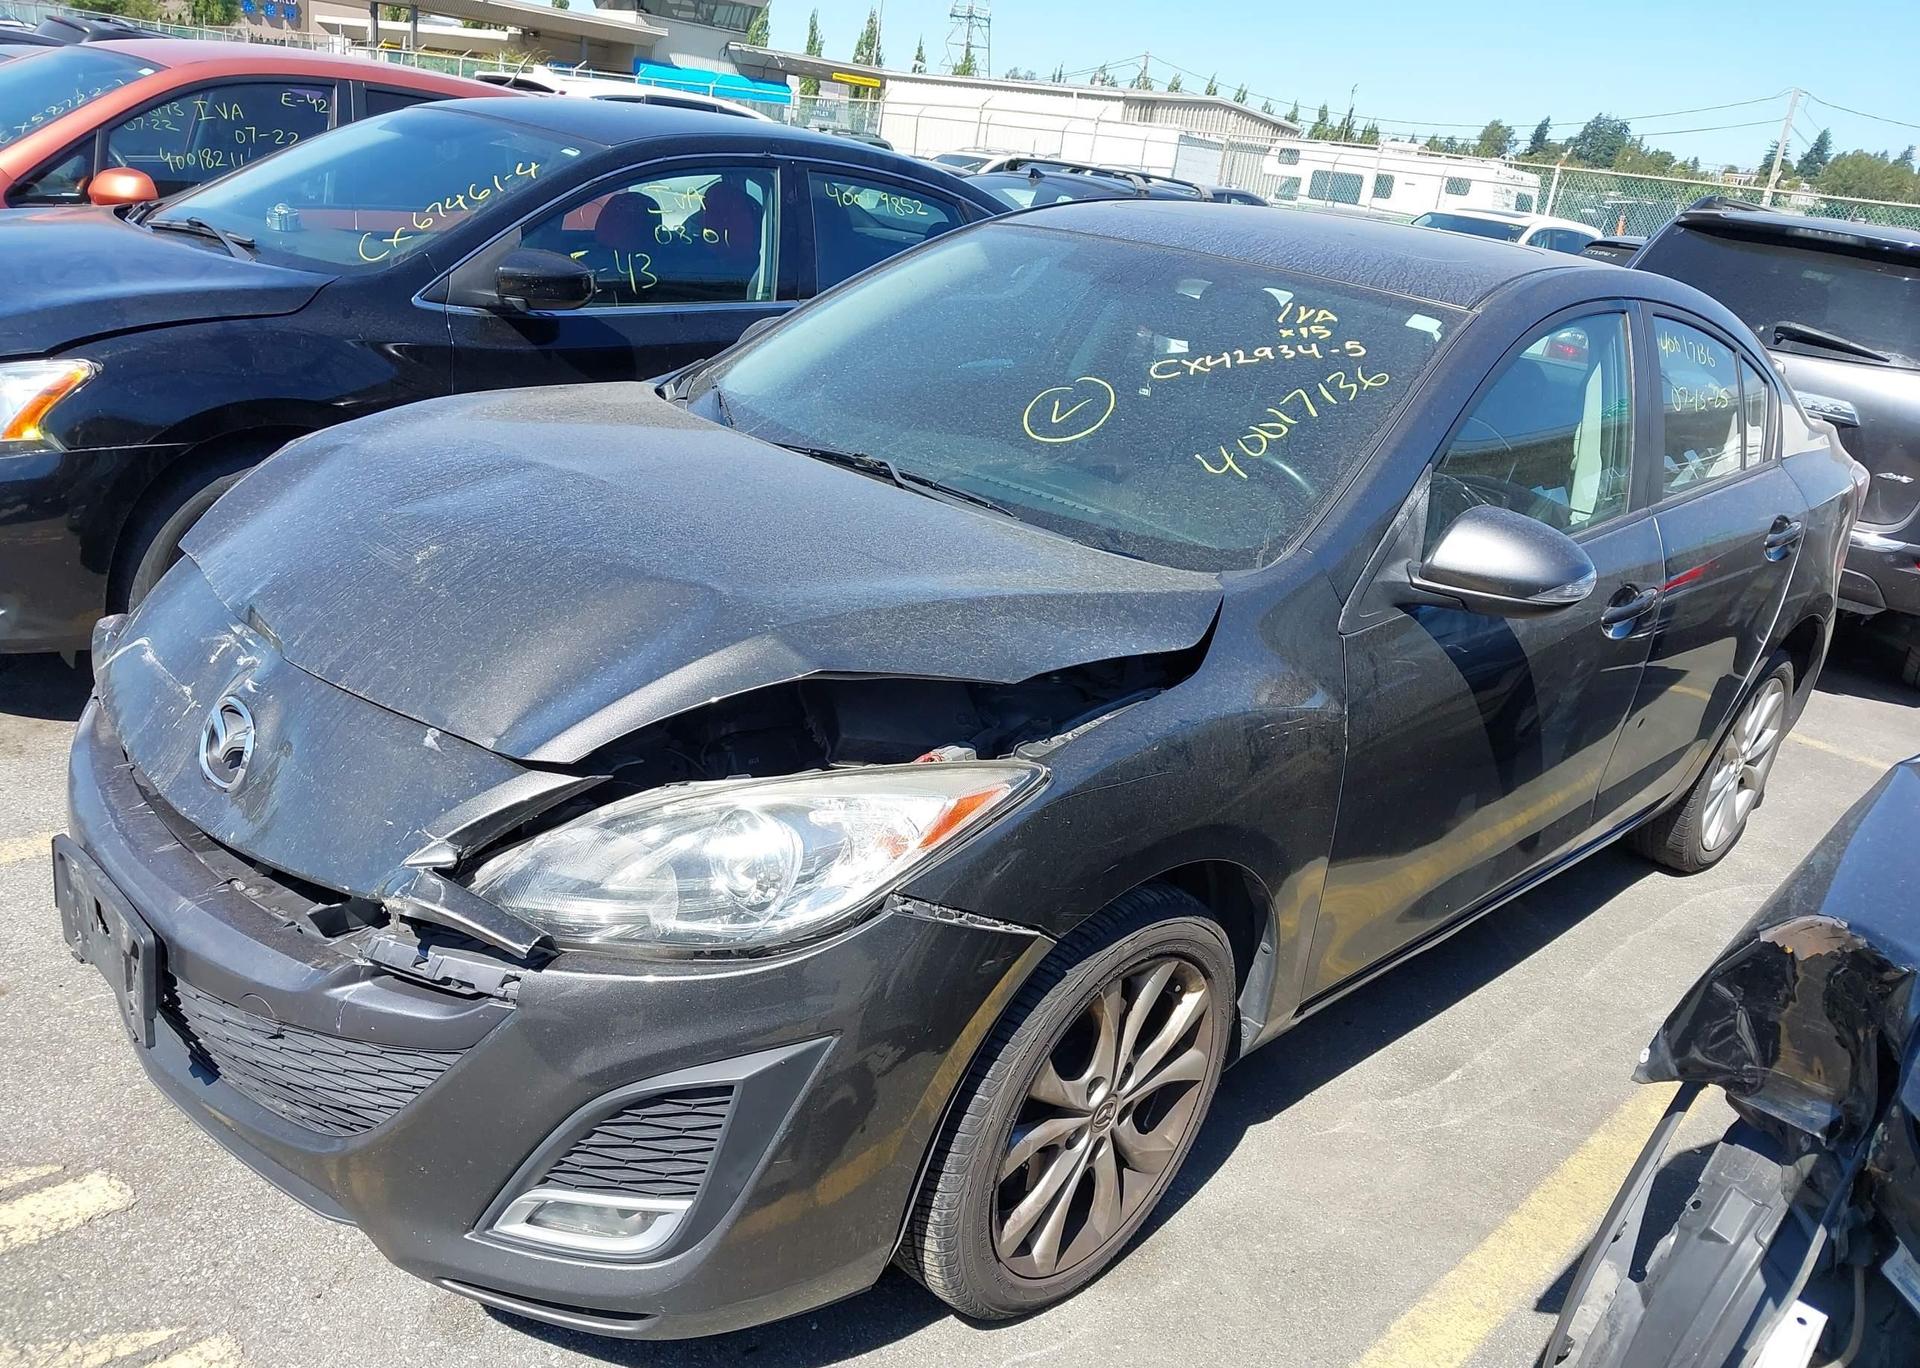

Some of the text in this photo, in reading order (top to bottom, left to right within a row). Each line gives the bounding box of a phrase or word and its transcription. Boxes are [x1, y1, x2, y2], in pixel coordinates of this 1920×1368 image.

[281, 92, 330, 114] E-42
[234, 126, 299, 146] 07-22
[1194, 365, 1390, 479] 40017136
